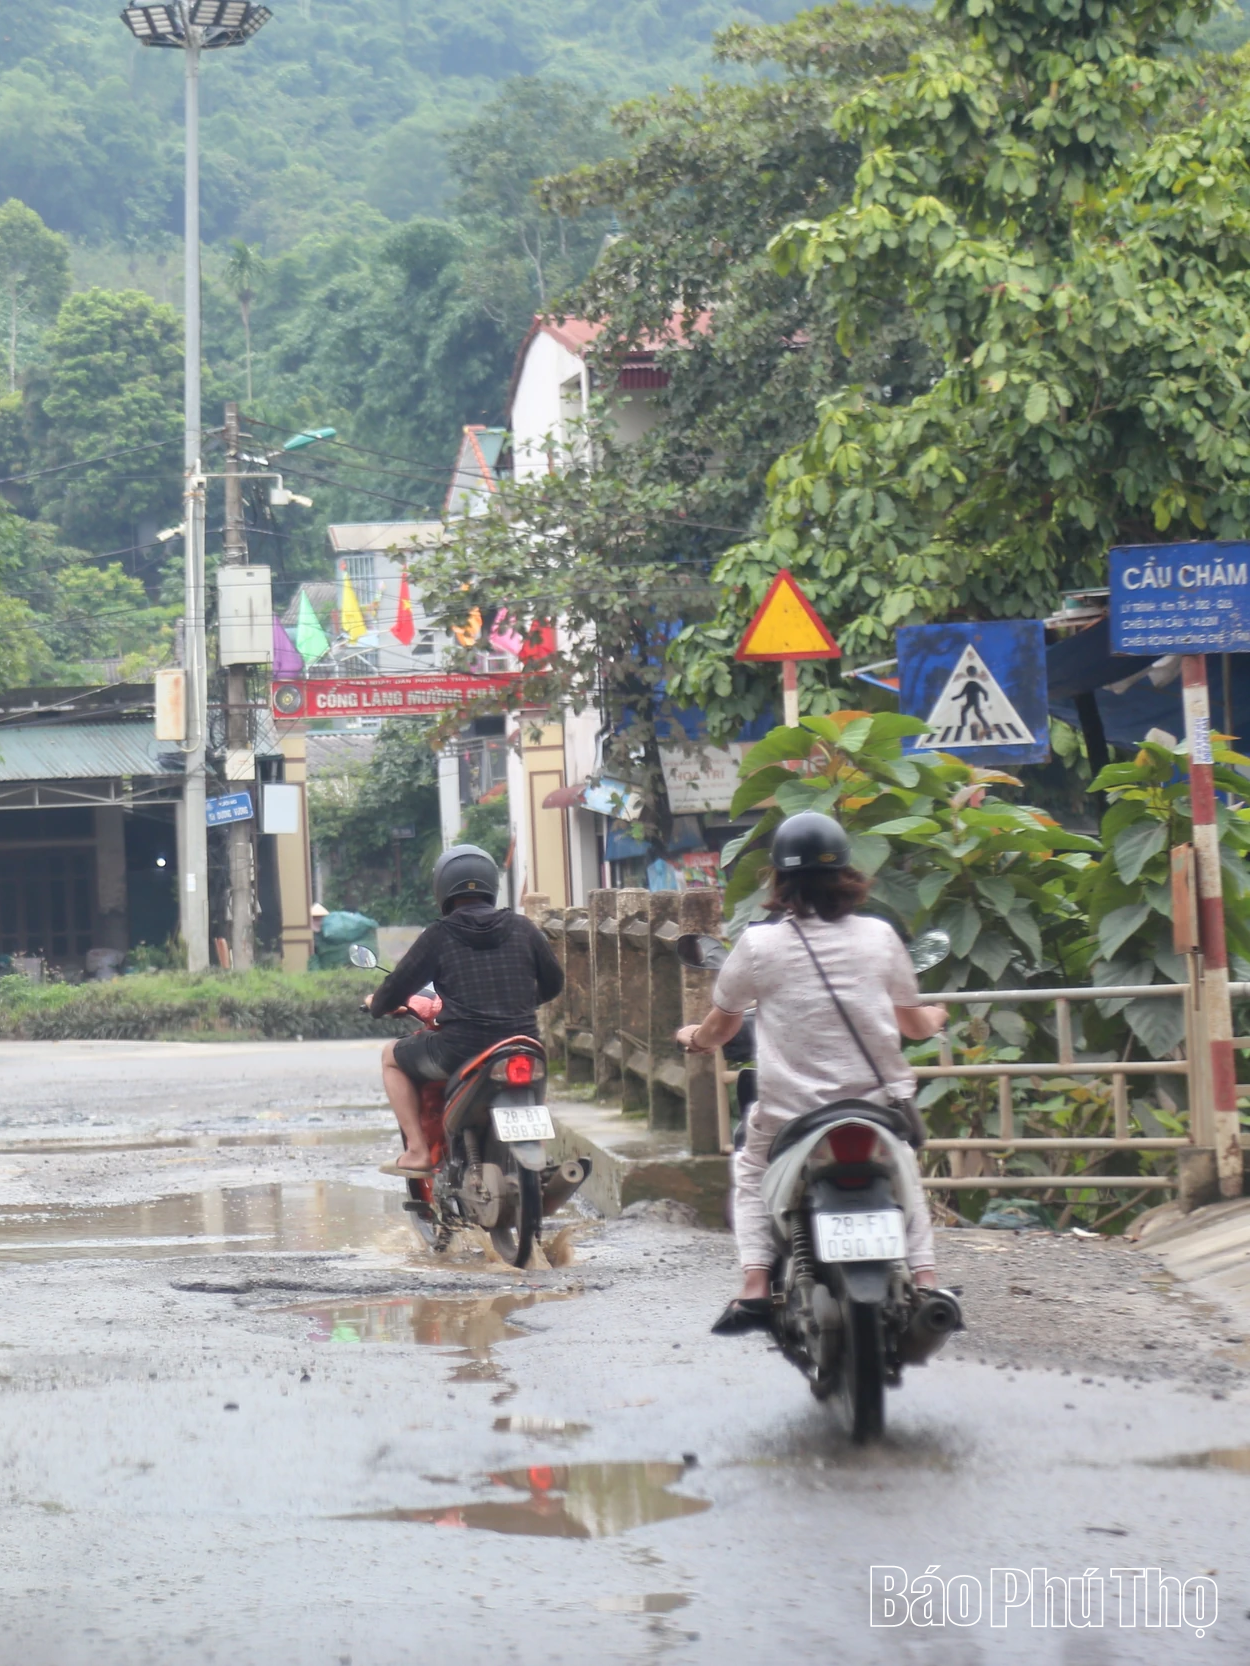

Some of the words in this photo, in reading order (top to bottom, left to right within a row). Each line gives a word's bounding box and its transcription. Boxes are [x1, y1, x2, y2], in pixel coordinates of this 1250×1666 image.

[1122, 556, 1172, 590] CẦU
[1177, 557, 1248, 588] CHĂM
[362, 688, 404, 707] LÀNG
[407, 686, 463, 705] MƯỜNG
[502, 1123, 547, 1138] 398.67
